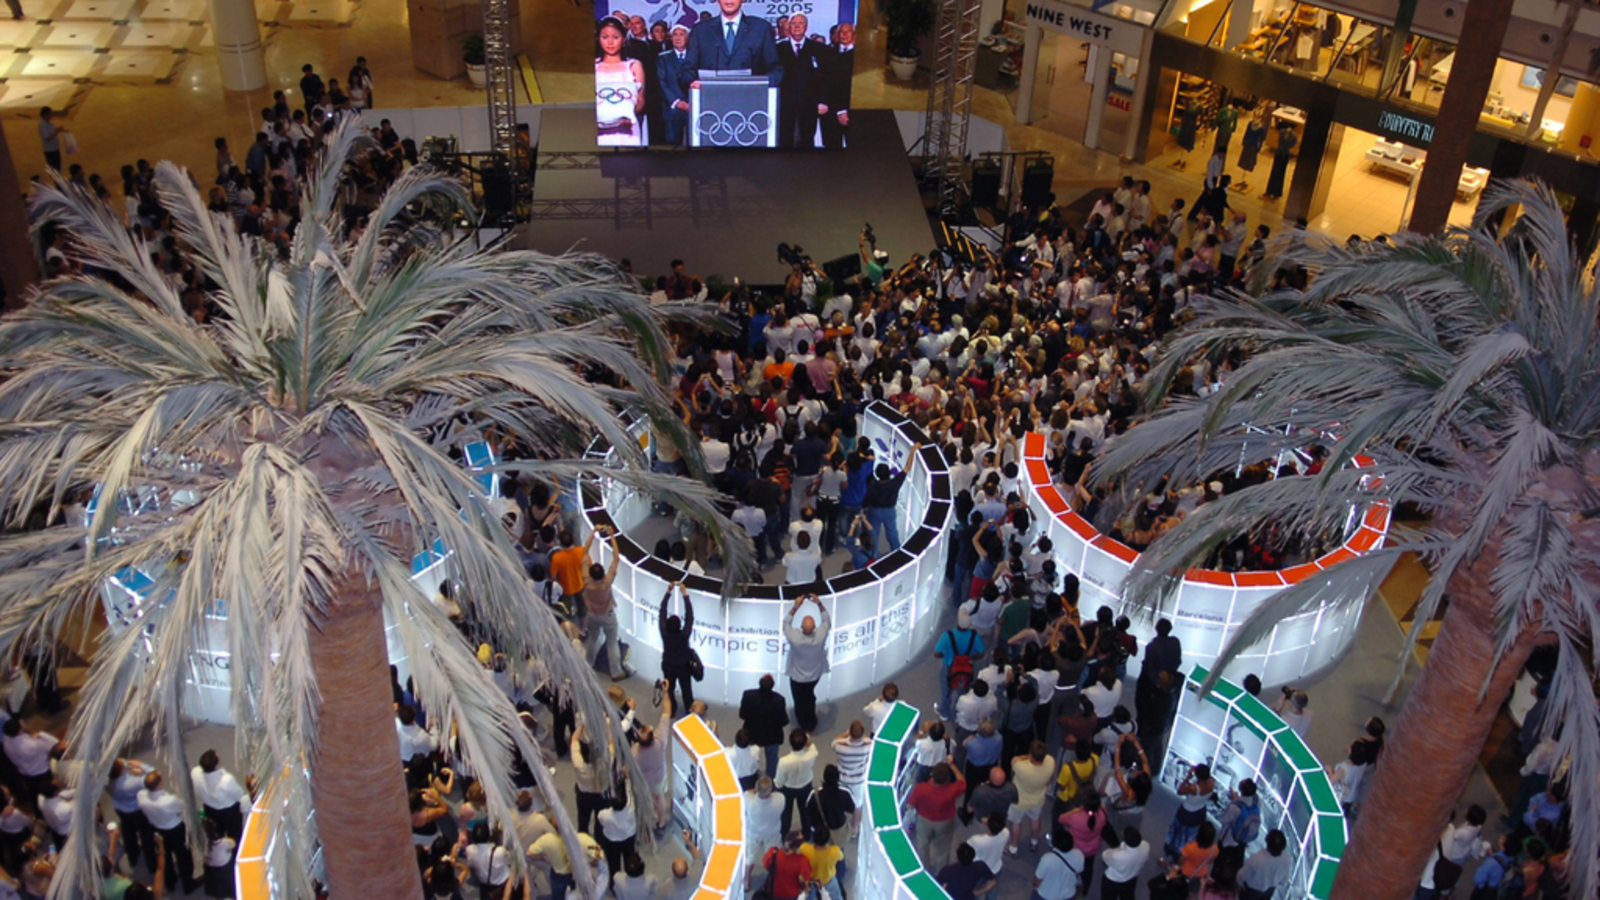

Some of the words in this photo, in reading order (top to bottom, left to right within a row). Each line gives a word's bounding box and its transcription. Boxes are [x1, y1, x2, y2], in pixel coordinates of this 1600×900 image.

[766, 3, 813, 15] 2005
[1026, 3, 1064, 26] NINE
[1070, 16, 1112, 40] WEST
[1108, 96, 1131, 112] SALE
[1177, 609, 1223, 622] Barcelona
[693, 628, 759, 654] lympic
[834, 630, 849, 645] is
[855, 619, 876, 637] all
[880, 602, 910, 627] this
[728, 626, 780, 636] Exhibition
